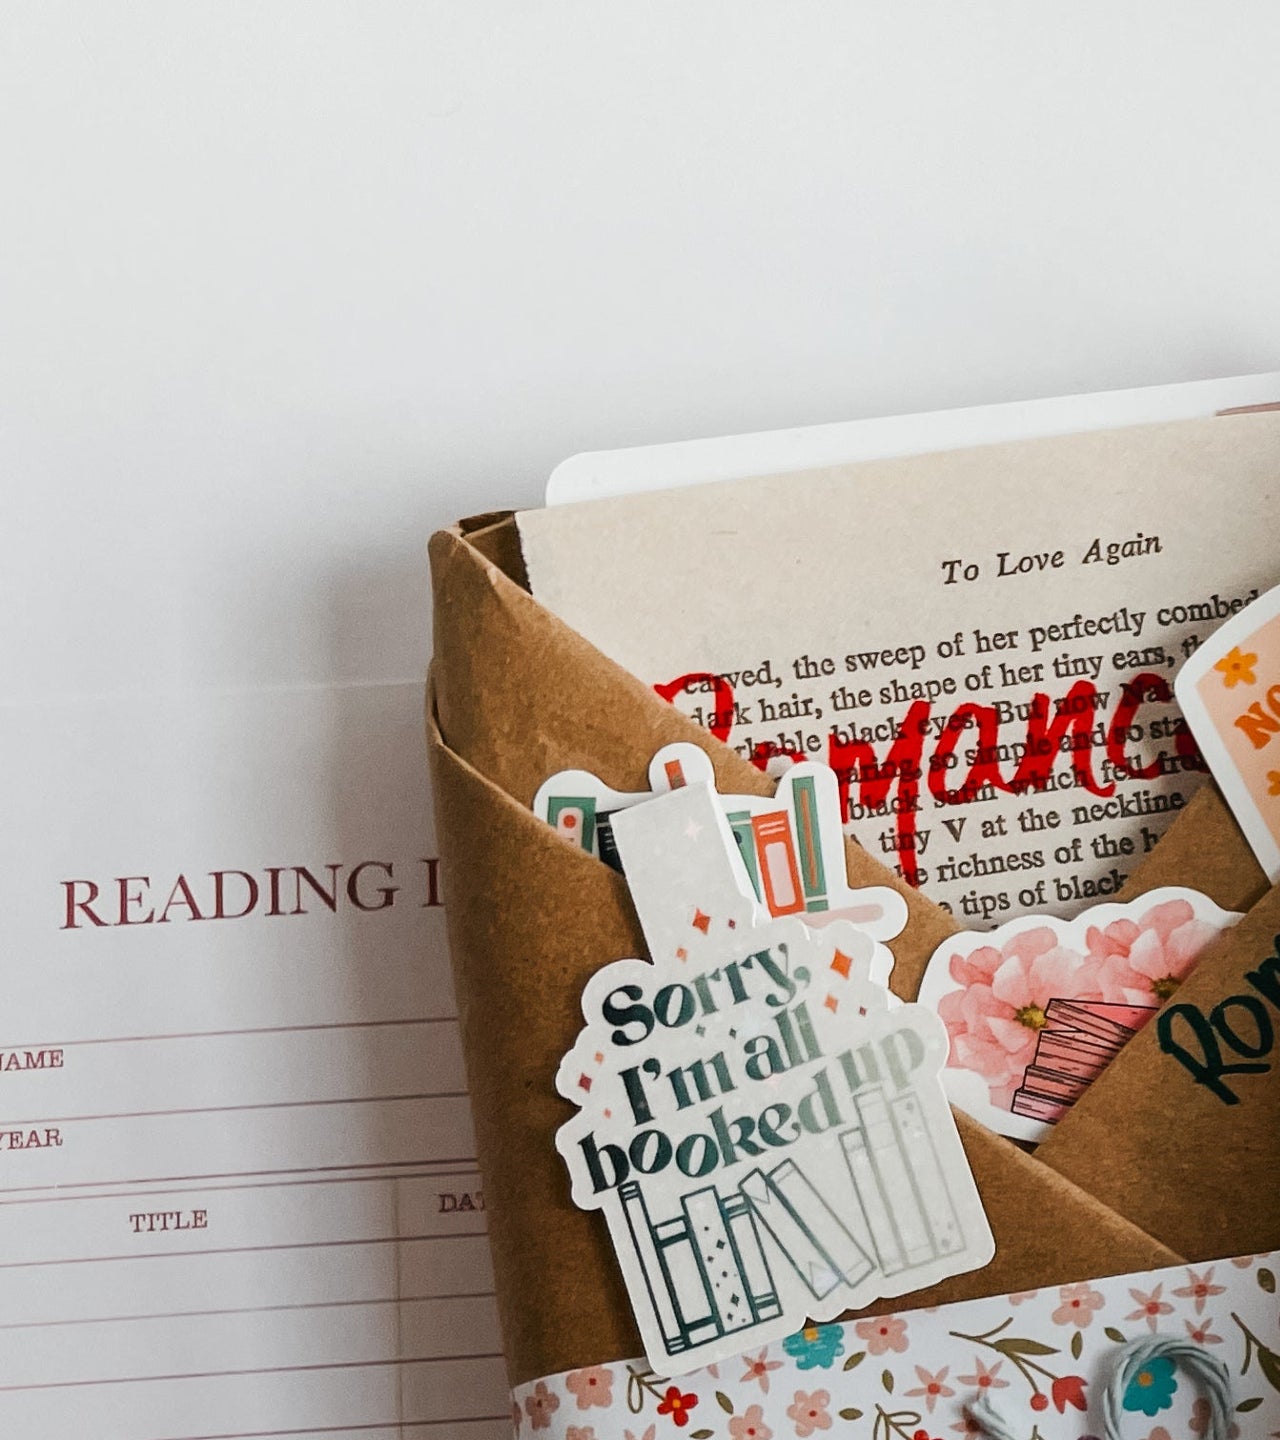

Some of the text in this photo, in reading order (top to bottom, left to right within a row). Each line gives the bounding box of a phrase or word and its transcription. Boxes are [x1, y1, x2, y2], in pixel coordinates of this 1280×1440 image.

[942, 532, 1162, 584] To Love Again
[682, 660, 782, 695] carved,
[792, 654, 835, 680] the
[845, 643, 926, 670] sweep
[937, 632, 964, 658] of
[974, 629, 1018, 654] her
[1029, 608, 1146, 652] perfectly
[759, 693, 823, 722] hair,
[829, 689, 873, 712] the
[880, 676, 957, 704] shape
[964, 665, 994, 690] of
[1000, 663, 1044, 687] her
[1054, 652, 1102, 680] tiny
[1113, 646, 1175, 671] ears,
[830, 716, 903, 748] black
[992, 698, 1044, 726] But
[1053, 690, 1111, 715] now
[930, 752, 958, 771] so
[1059, 724, 1107, 752] and
[934, 780, 997, 808] satin
[1010, 763, 1087, 798] which
[1100, 754, 1143, 783] fell
[879, 826, 931, 855] tiny
[942, 818, 967, 844] V
[982, 817, 1007, 838] at
[1017, 807, 1061, 832] the
[1072, 788, 1186, 824] neckline
[937, 854, 1045, 883] richness
[1054, 839, 1082, 864] of
[1091, 830, 1135, 858] the
[59, 861, 400, 930] READING
[960, 893, 1011, 920] tips
[1018, 882, 1047, 908] of
[1055, 868, 1129, 901] black
[601, 942, 811, 1047] Sorry,
[0, 1048, 64, 1072] AME
[619, 1000, 823, 1127] I'm all
[578, 1025, 927, 1195] booked up
[129, 1209, 208, 1233] TITLE
